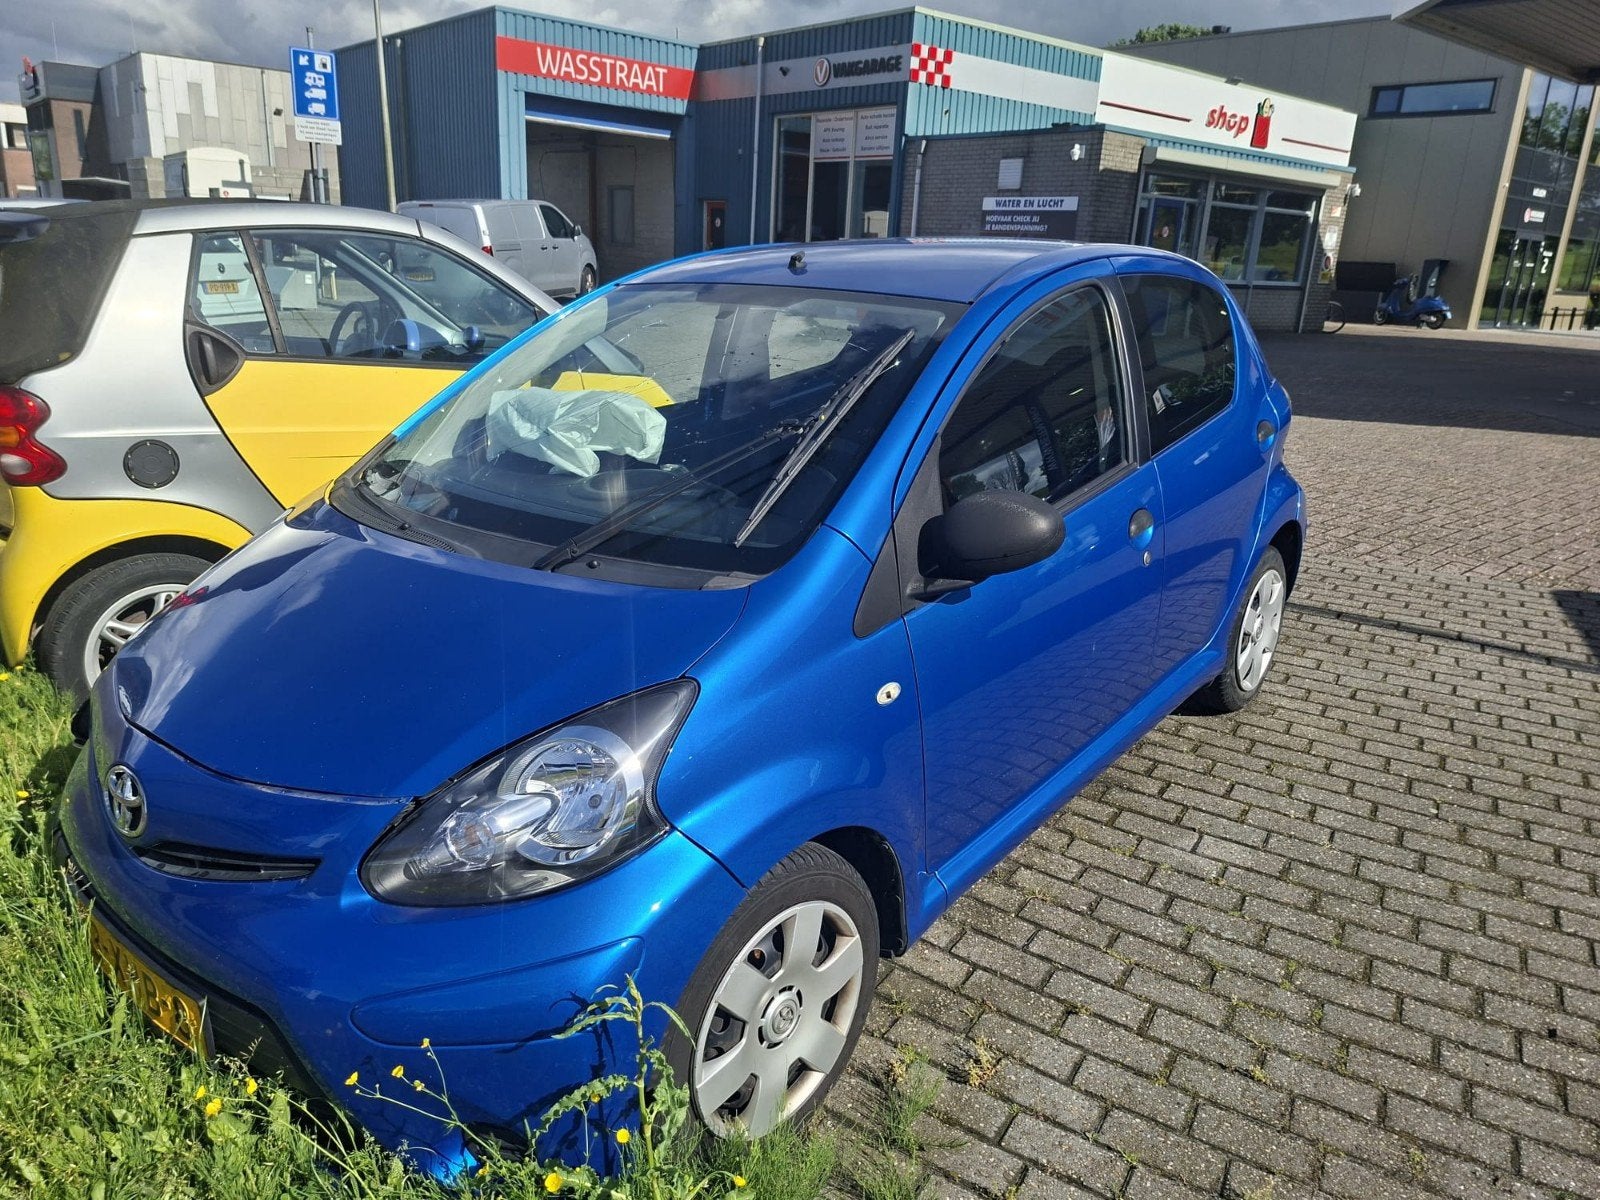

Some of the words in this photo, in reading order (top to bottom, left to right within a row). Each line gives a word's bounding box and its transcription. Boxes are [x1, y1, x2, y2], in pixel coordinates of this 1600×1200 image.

[536, 46, 668, 93] WASSTRAAT
[1205, 104, 1250, 139] shop
[995, 199, 1022, 208] WATER
[1023, 199, 1035, 208] EN
[1037, 199, 1065, 208] LUCHT
[1031, 215, 1040, 223] JIJ
[991, 224, 1049, 232] BANDENSPANNING?
[1540, 257, 1549, 273] 2
